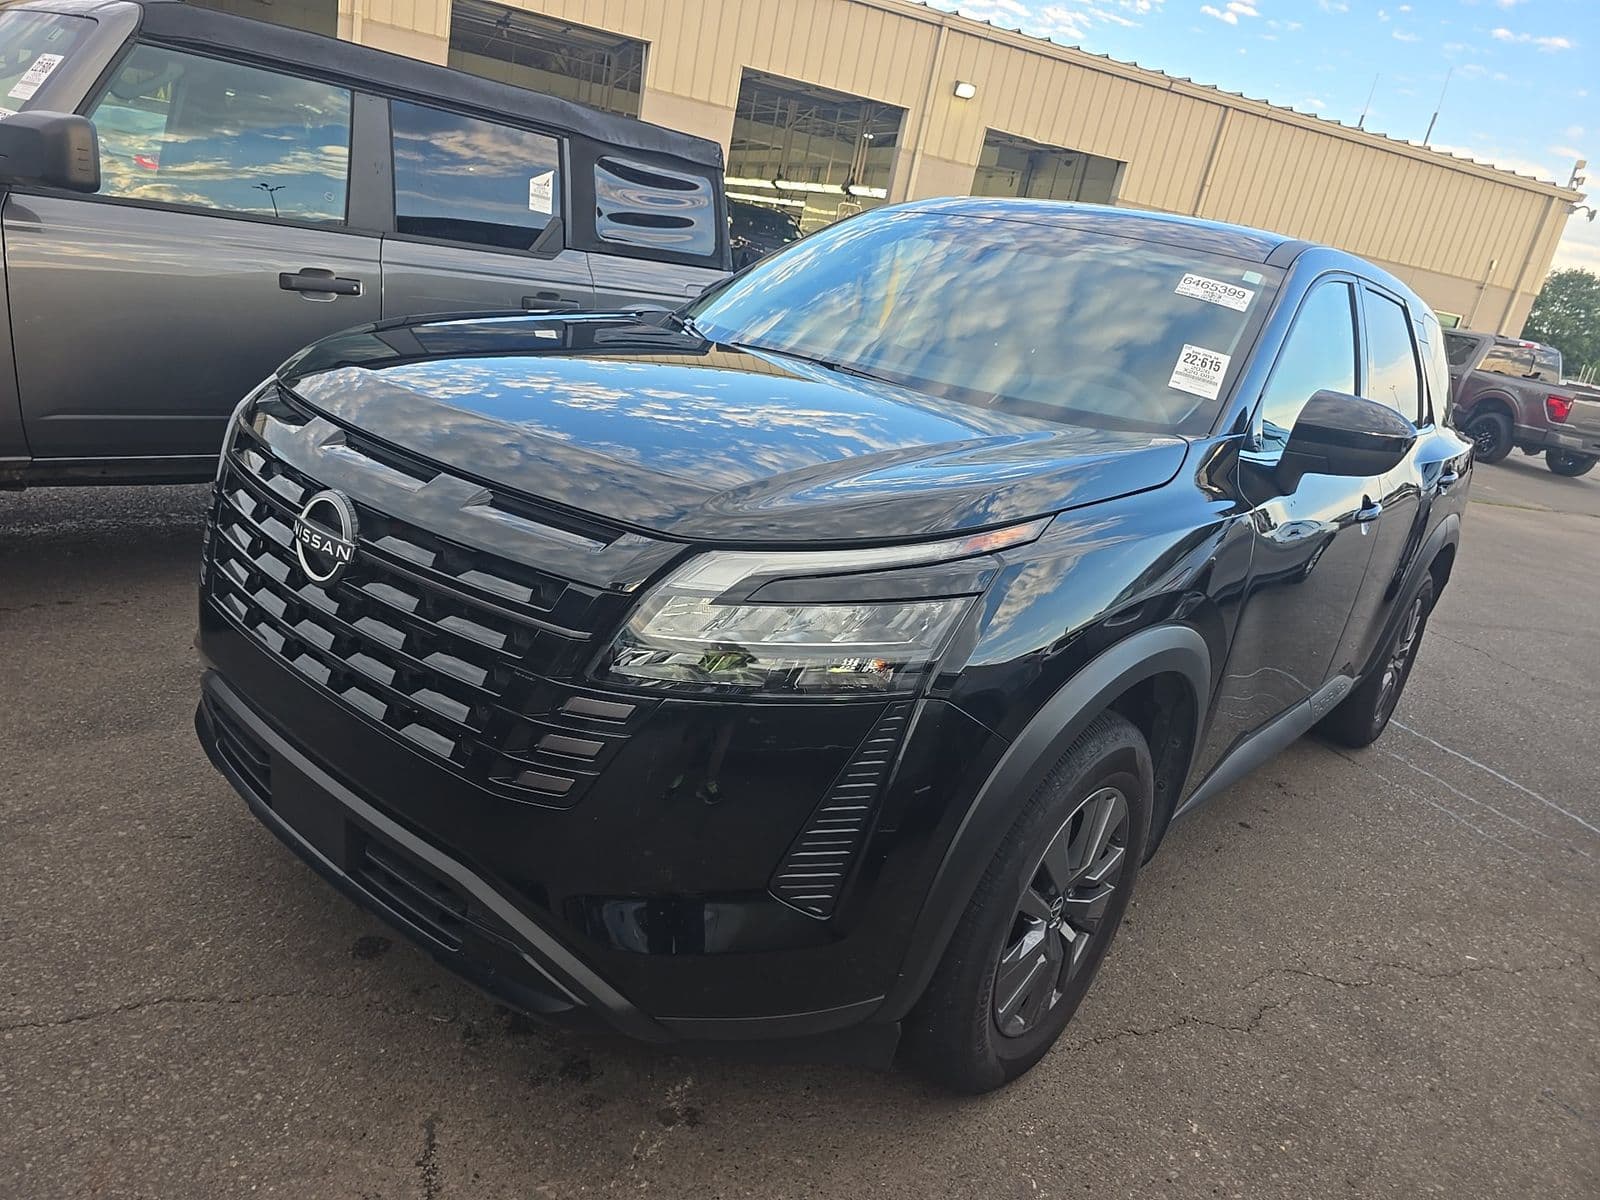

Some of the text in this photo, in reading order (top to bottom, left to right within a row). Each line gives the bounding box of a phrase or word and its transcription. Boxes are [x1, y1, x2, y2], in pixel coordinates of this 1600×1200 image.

[1183, 276, 1246, 300] 6465399
[1183, 353, 1222, 372] 22:615
[293, 519, 351, 561] NISSAN
